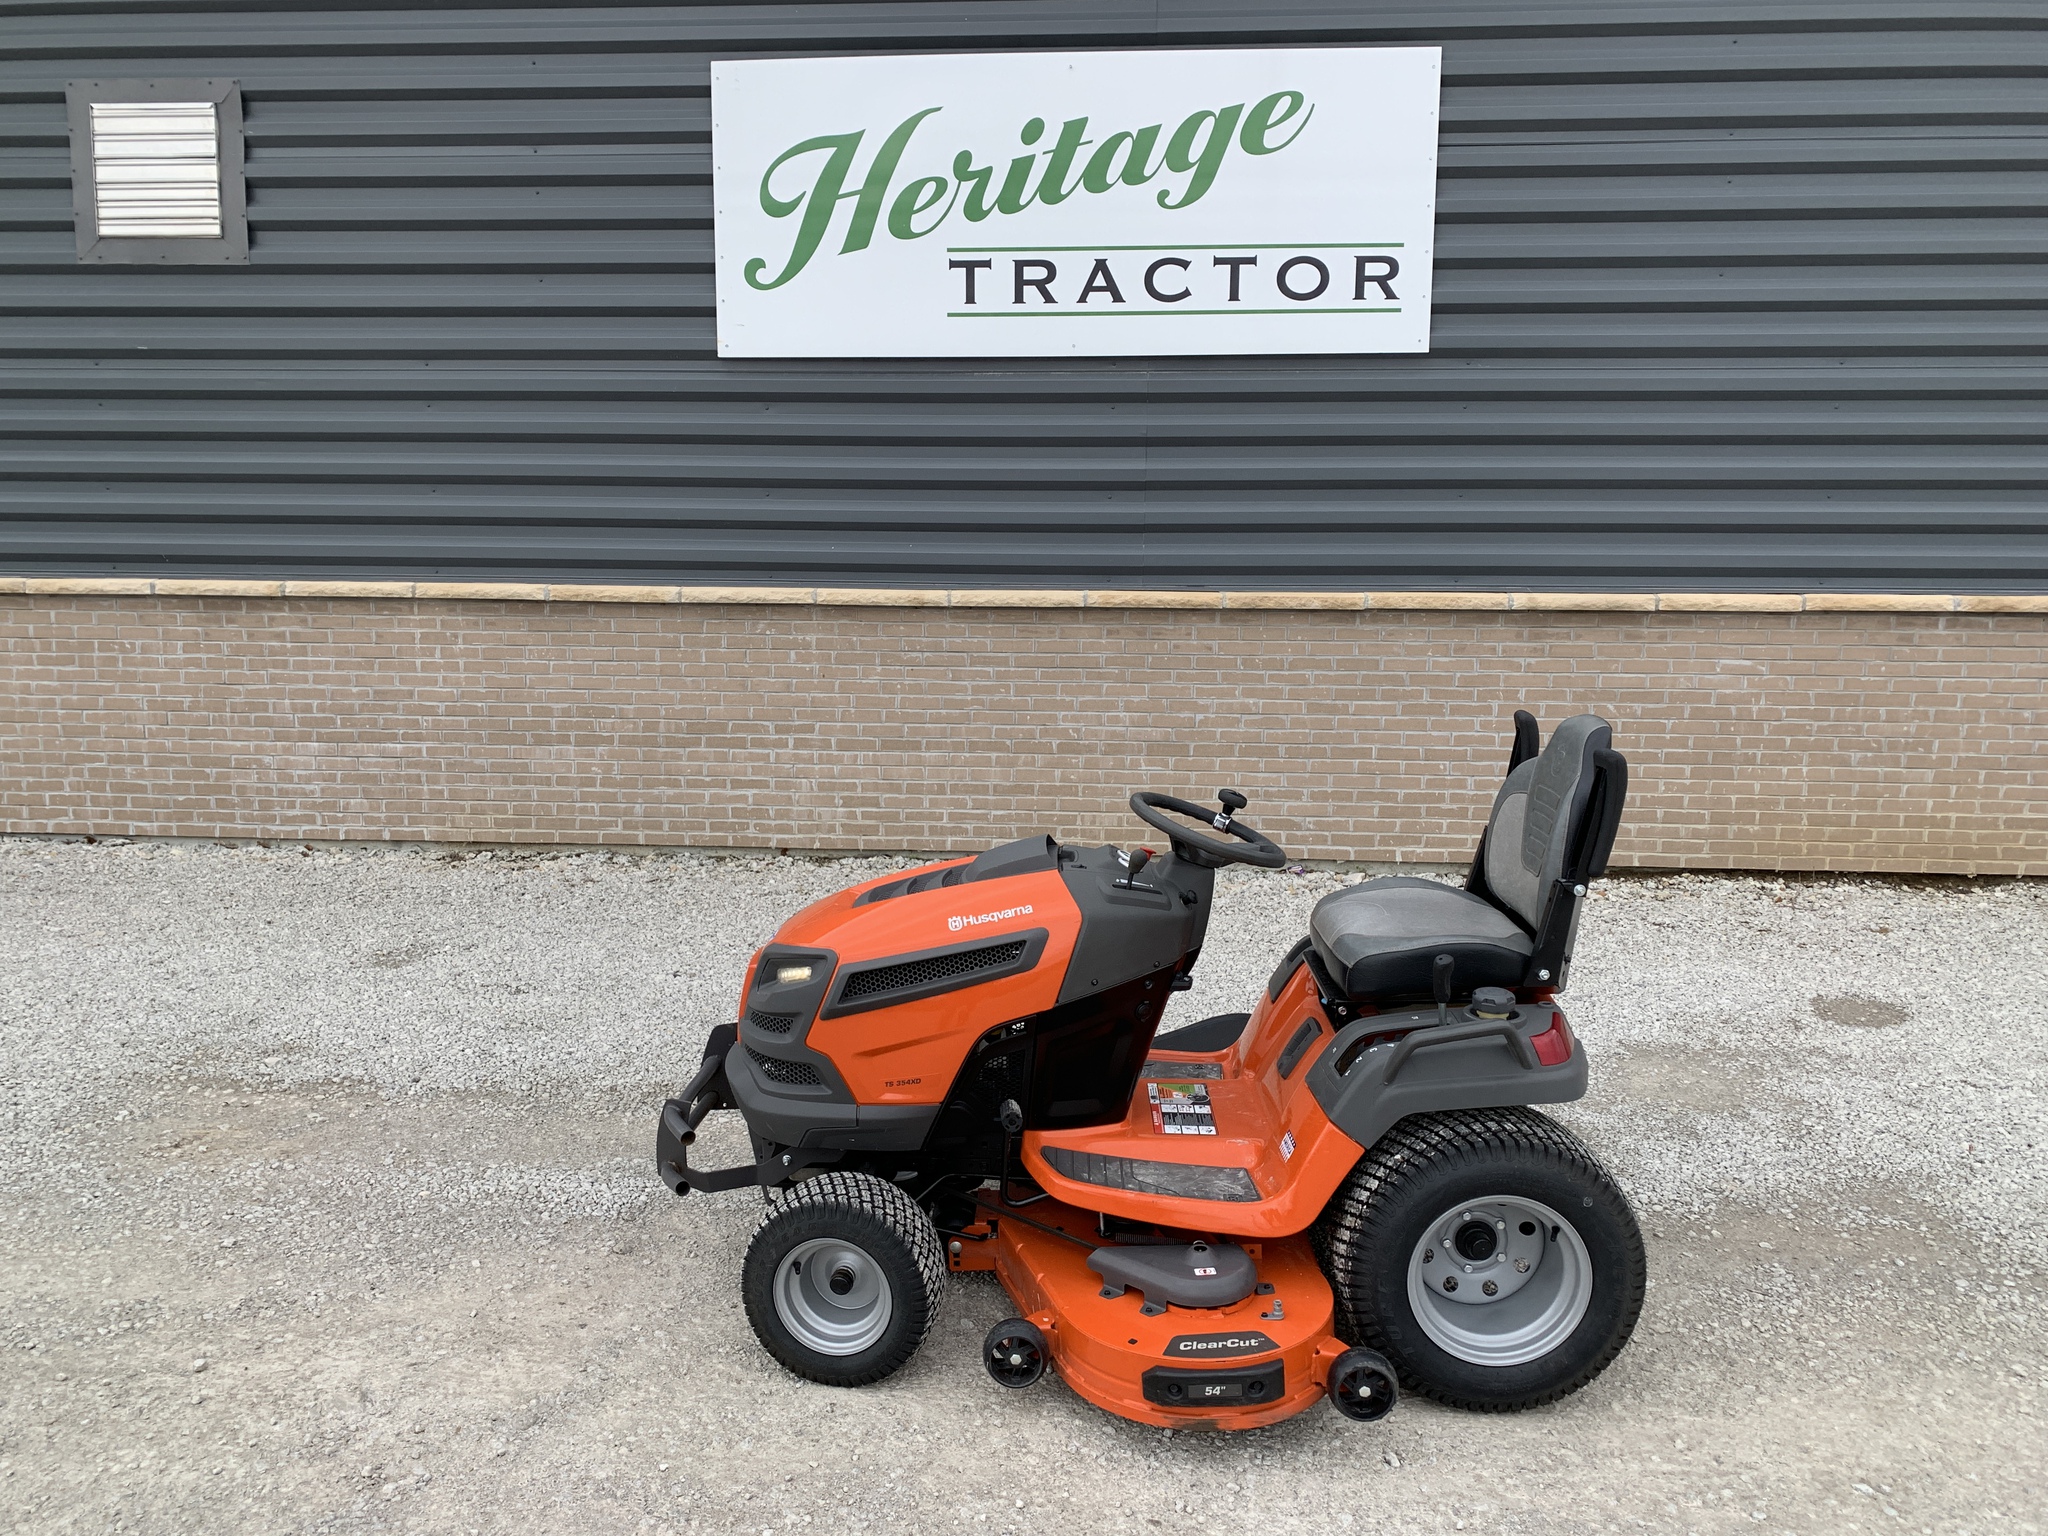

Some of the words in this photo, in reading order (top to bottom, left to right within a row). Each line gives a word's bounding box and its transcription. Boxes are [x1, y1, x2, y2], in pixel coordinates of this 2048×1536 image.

[744, 90, 1315, 291] Heritage
[948, 255, 1401, 305] TRACTOR
[962, 904, 1034, 927] Husqvarna
